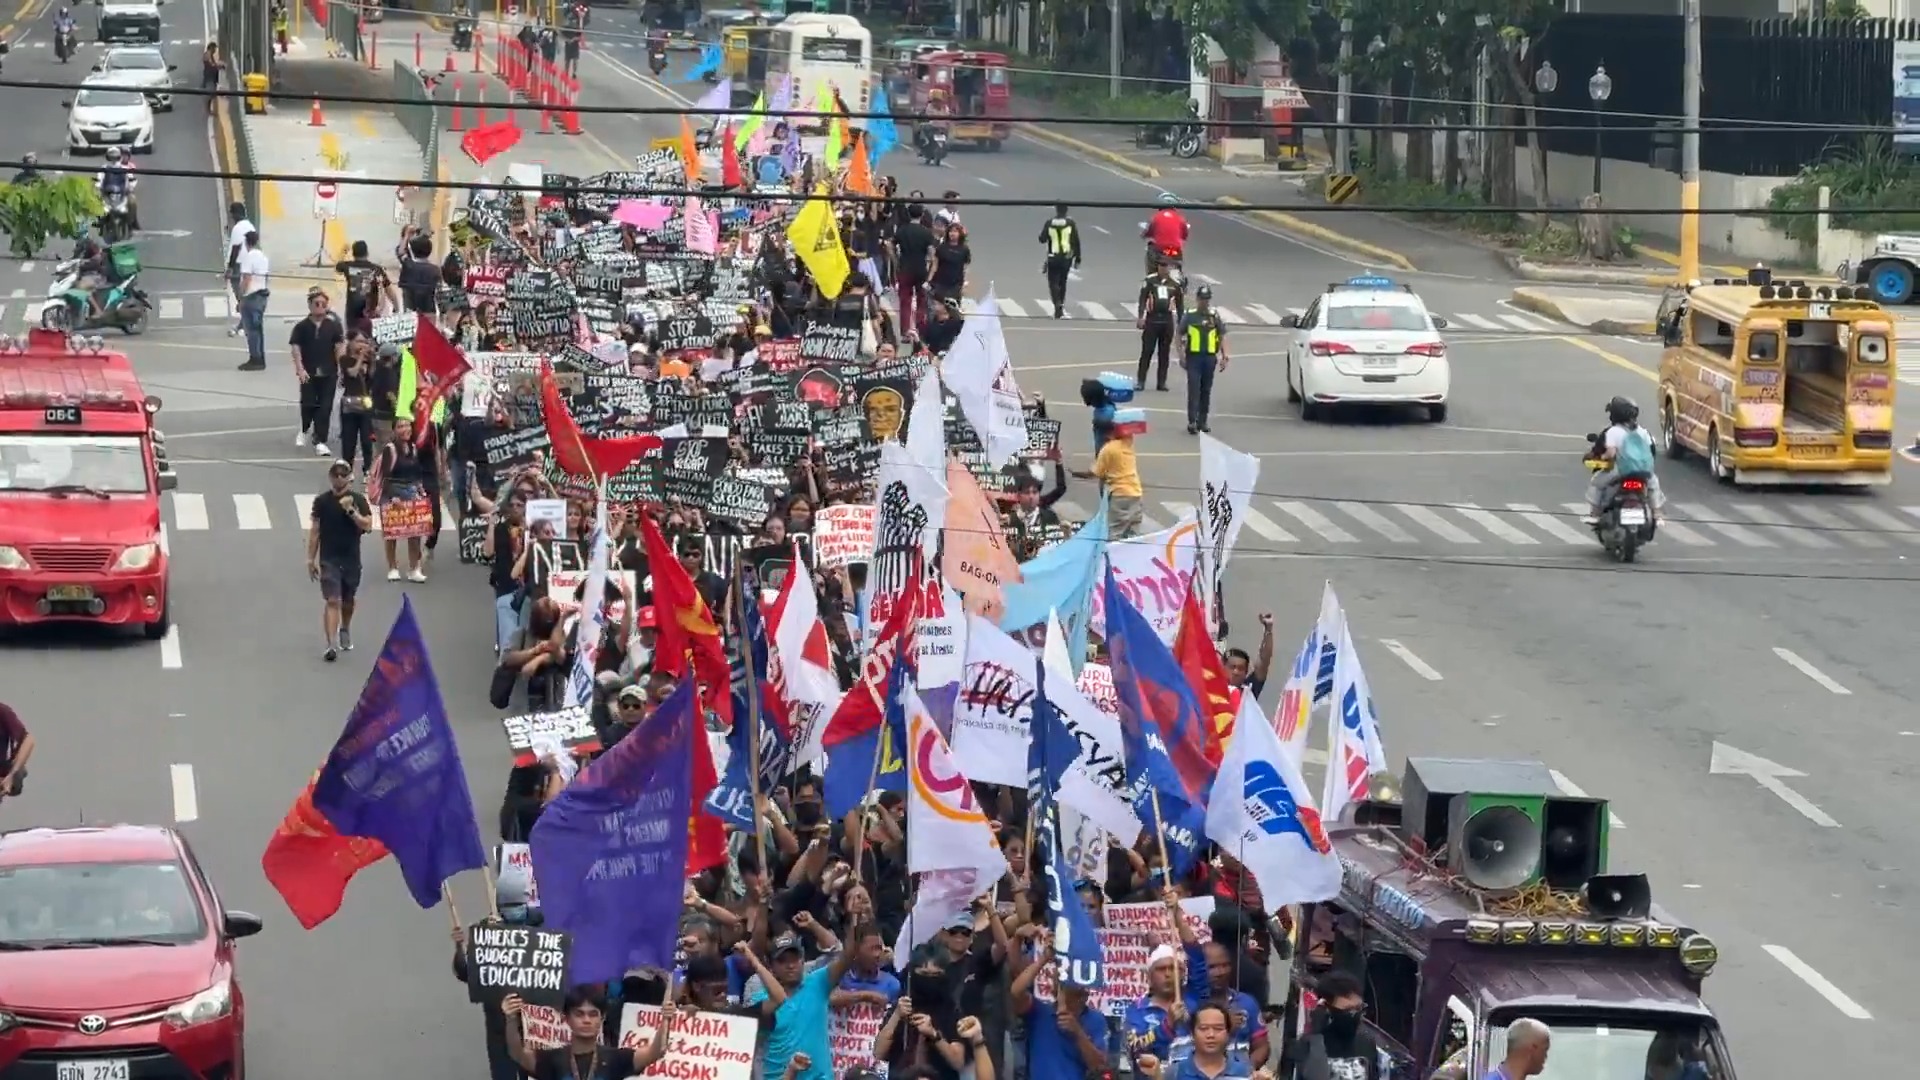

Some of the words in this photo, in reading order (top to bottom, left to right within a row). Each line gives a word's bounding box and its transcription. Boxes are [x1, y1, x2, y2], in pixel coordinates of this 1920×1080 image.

[669, 321, 697, 337] STOP
[474, 927, 530, 949] WHERE'S
[537, 931, 563, 951] THE
[475, 947, 527, 966] BUDGET
[533, 950, 564, 967] FOR
[479, 966, 562, 990] EDUCATION
